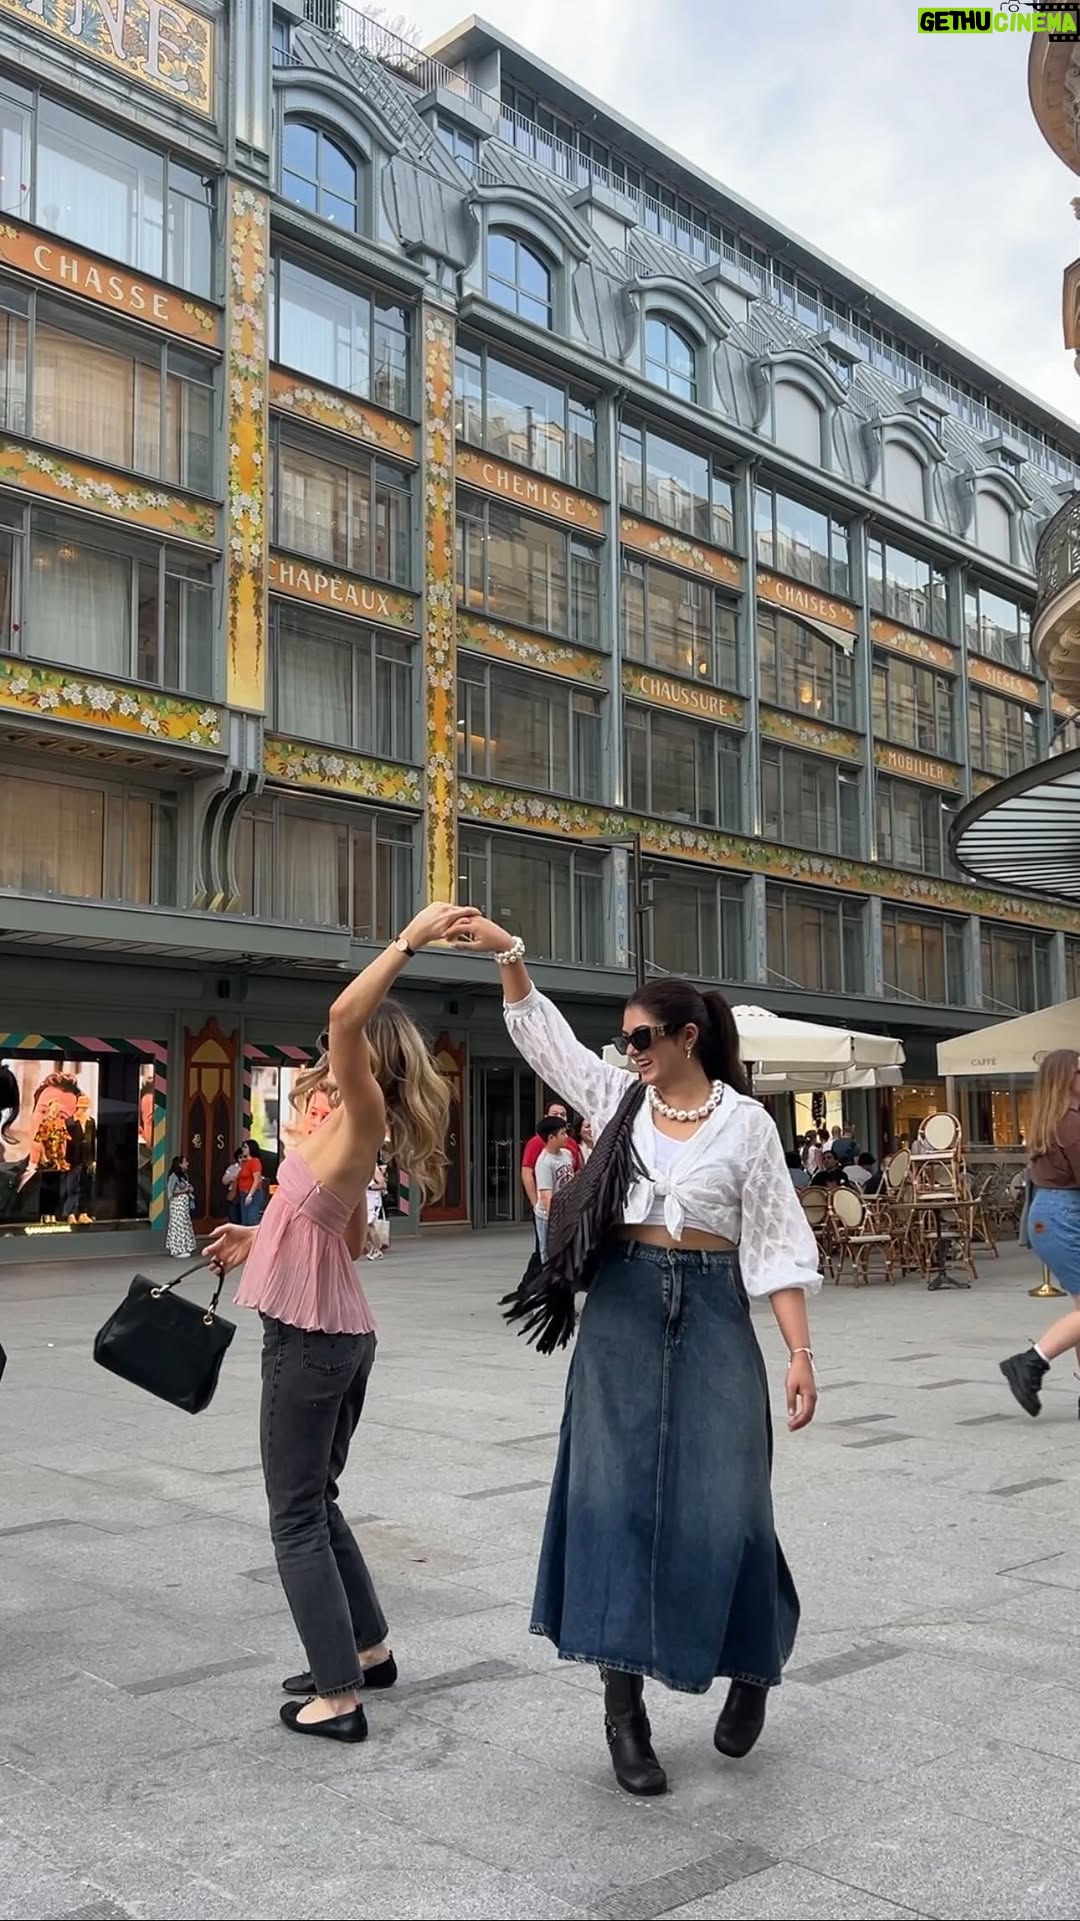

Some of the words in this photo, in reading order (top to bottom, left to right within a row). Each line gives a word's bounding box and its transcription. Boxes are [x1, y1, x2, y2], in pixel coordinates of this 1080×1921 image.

[34, 245, 169, 320] CHASSE
[482, 464, 576, 516] CHEMISE
[775, 582, 837, 619] CHAISES
[640, 676, 728, 716] CHAUSSURE
[985, 666, 1024, 693] SIEGES
[888, 751, 944, 781] MOBILIER
